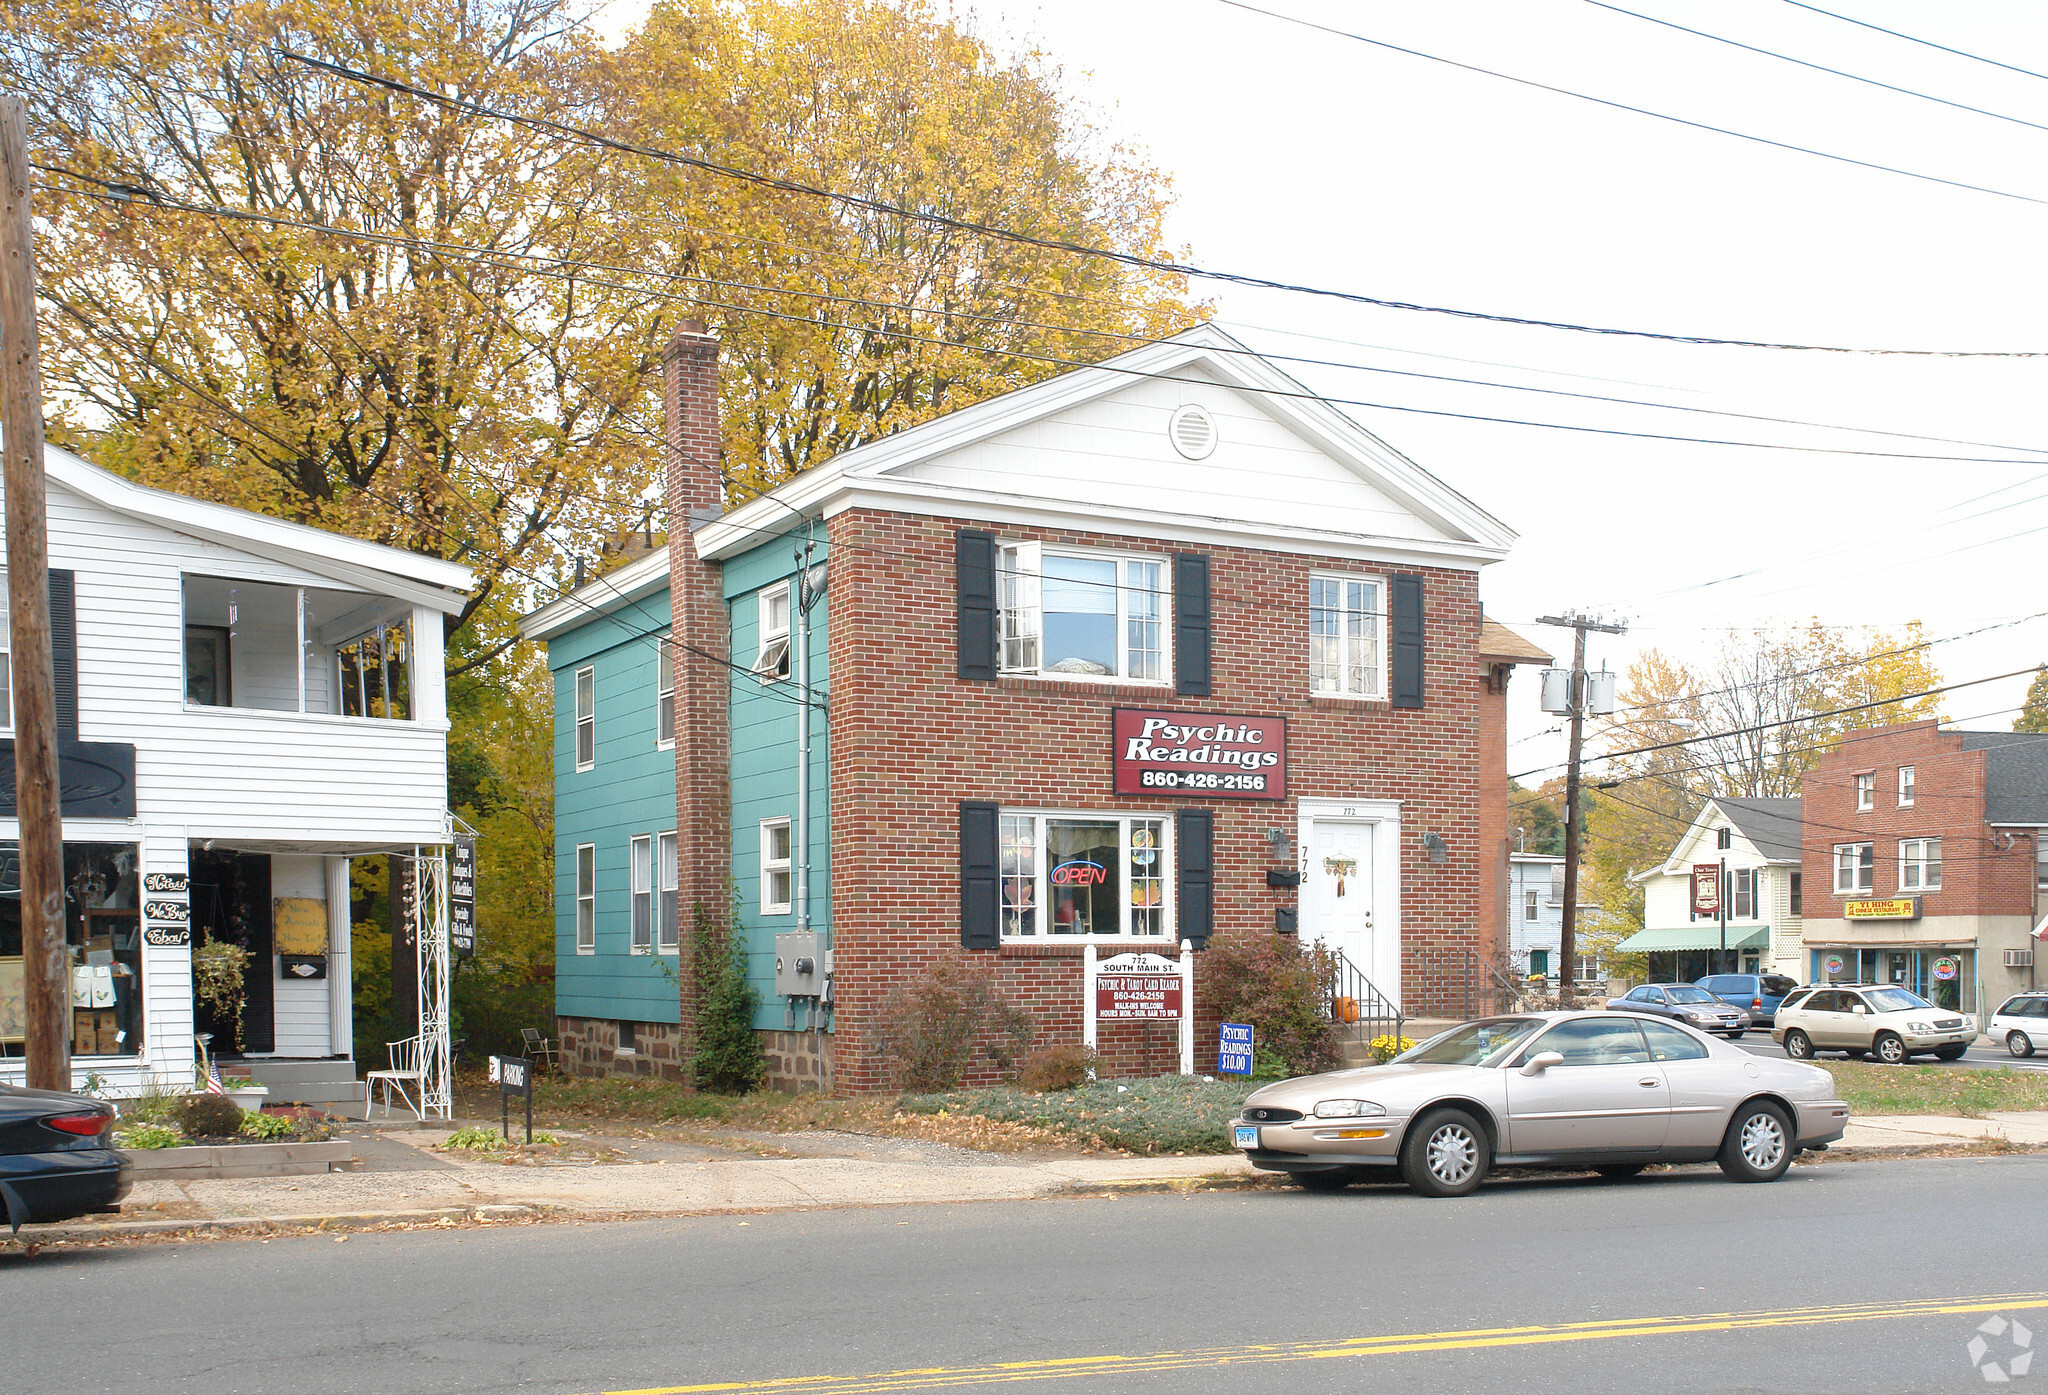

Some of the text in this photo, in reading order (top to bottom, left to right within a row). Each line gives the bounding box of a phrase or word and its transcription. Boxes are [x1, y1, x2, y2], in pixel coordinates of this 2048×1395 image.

[1139, 717, 1263, 745] Psychic
[1123, 737, 1279, 771] Readings
[1142, 771, 1265, 791] 860-426-2156
[1343, 807, 1356, 816] 772
[146, 873, 190, 891] Notary
[1053, 867, 1107, 885] OPEN
[147, 903, 190, 920] We Buy
[1872, 900, 1894, 908] HING
[147, 929, 190, 945] Ebay
[1103, 964, 1134, 972] SOUTH
[1136, 964, 1160, 972] MAIN
[1131, 957, 1147, 965] 772
[1120, 978, 1126, 990] &
[1144, 978, 1158, 991] CARD
[1113, 991, 1165, 1000] 860-426-2156
[1100, 1009, 1118, 1017] HOURS
[1221, 1024, 1249, 1041] PSYCHIC
[1219, 1040, 1252, 1056] READINGS
[1221, 1055, 1246, 1071] $10.00
[503, 1063, 525, 1087] PARKING
